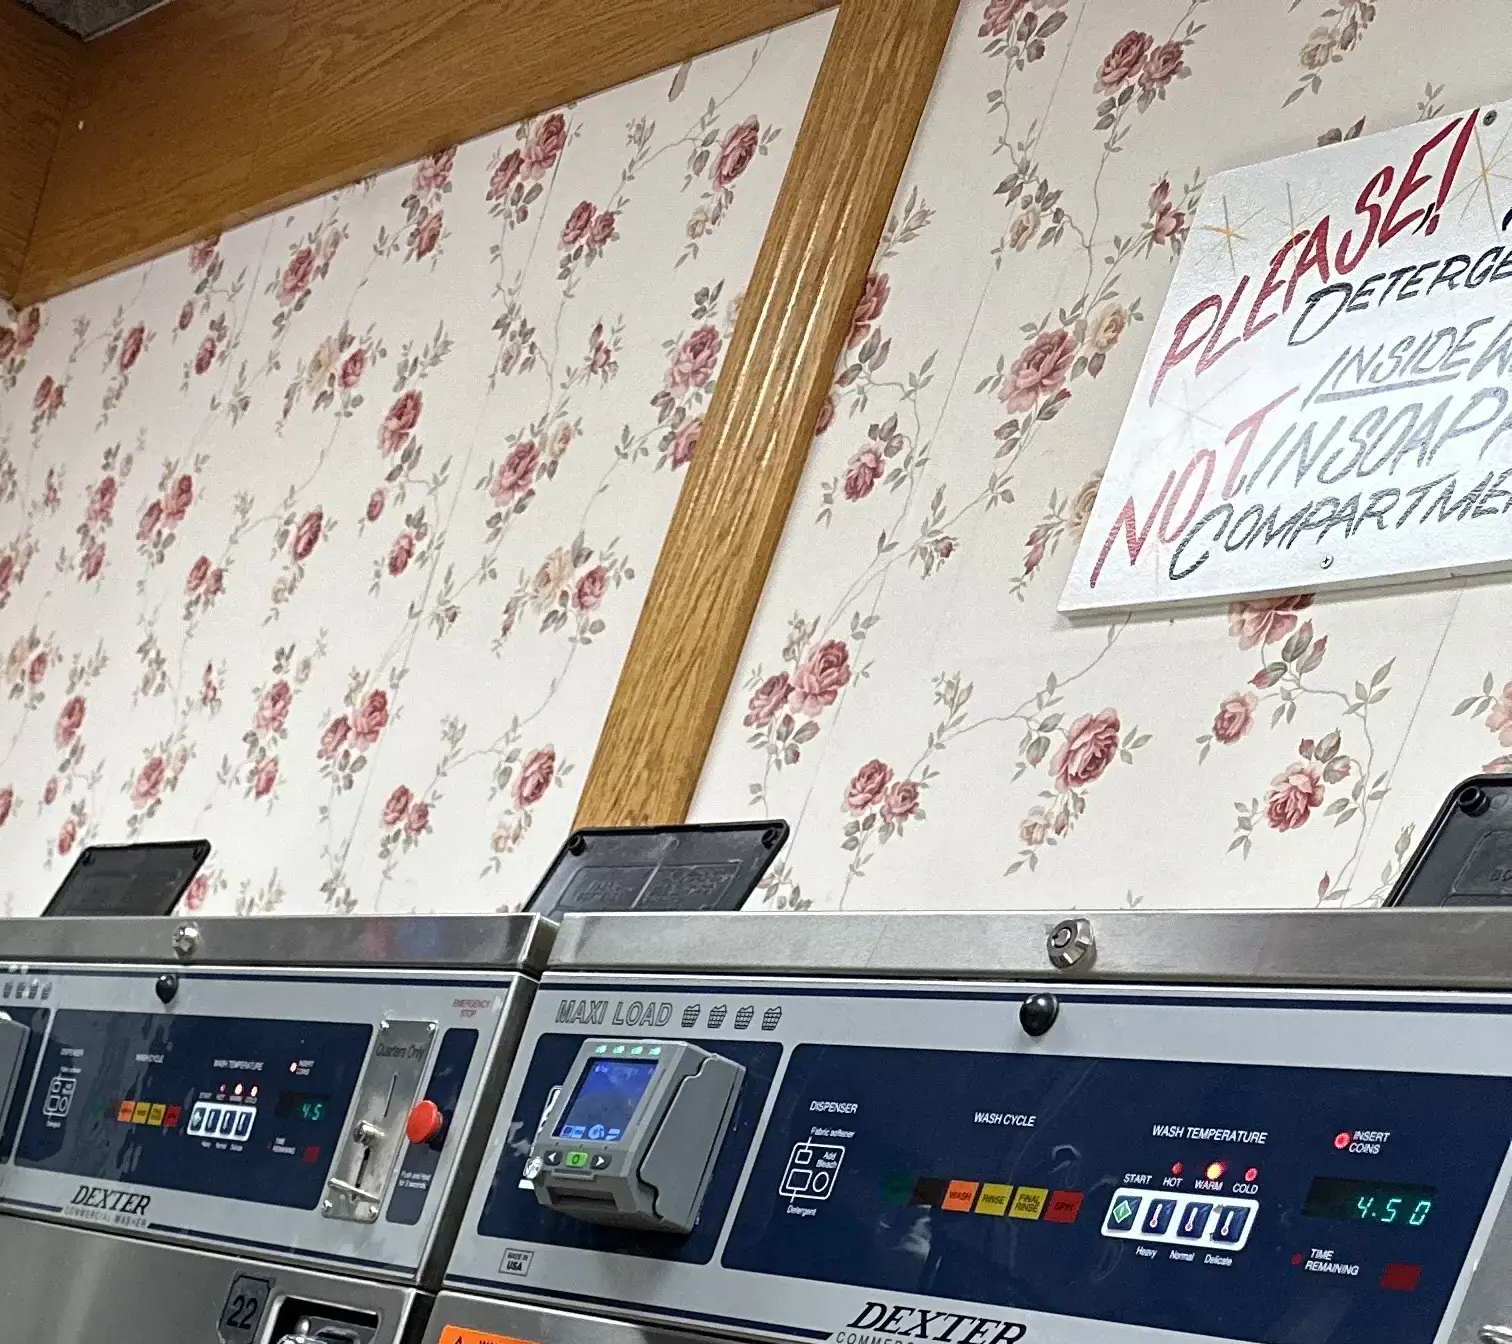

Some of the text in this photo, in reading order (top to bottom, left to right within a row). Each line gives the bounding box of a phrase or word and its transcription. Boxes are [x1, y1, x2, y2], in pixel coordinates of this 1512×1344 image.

[1148, 107, 1479, 408] PLEASE!
[1299, 315, 1495, 412] INSIDE
[1089, 383, 1301, 589] NOT
[554, 999, 674, 1027] MAXI LOAD
[809, 1100, 858, 1114] DISPENSER
[974, 1111, 1036, 1128] WASH CYCLE
[1152, 1124, 1269, 1145] WASH TEMPERATURE
[1352, 1131, 1390, 1142] INSERT
[1349, 1142, 1381, 1155] COINS
[1123, 1173, 1259, 1195] START HOT WARM COLD
[69, 1185, 151, 1216] DEXTER
[1357, 1196, 1431, 1226] 4.50
[1310, 1248, 1334, 1261] TIME
[1304, 1260, 1360, 1276] REMAINING
[226, 1295, 258, 1330] 22
